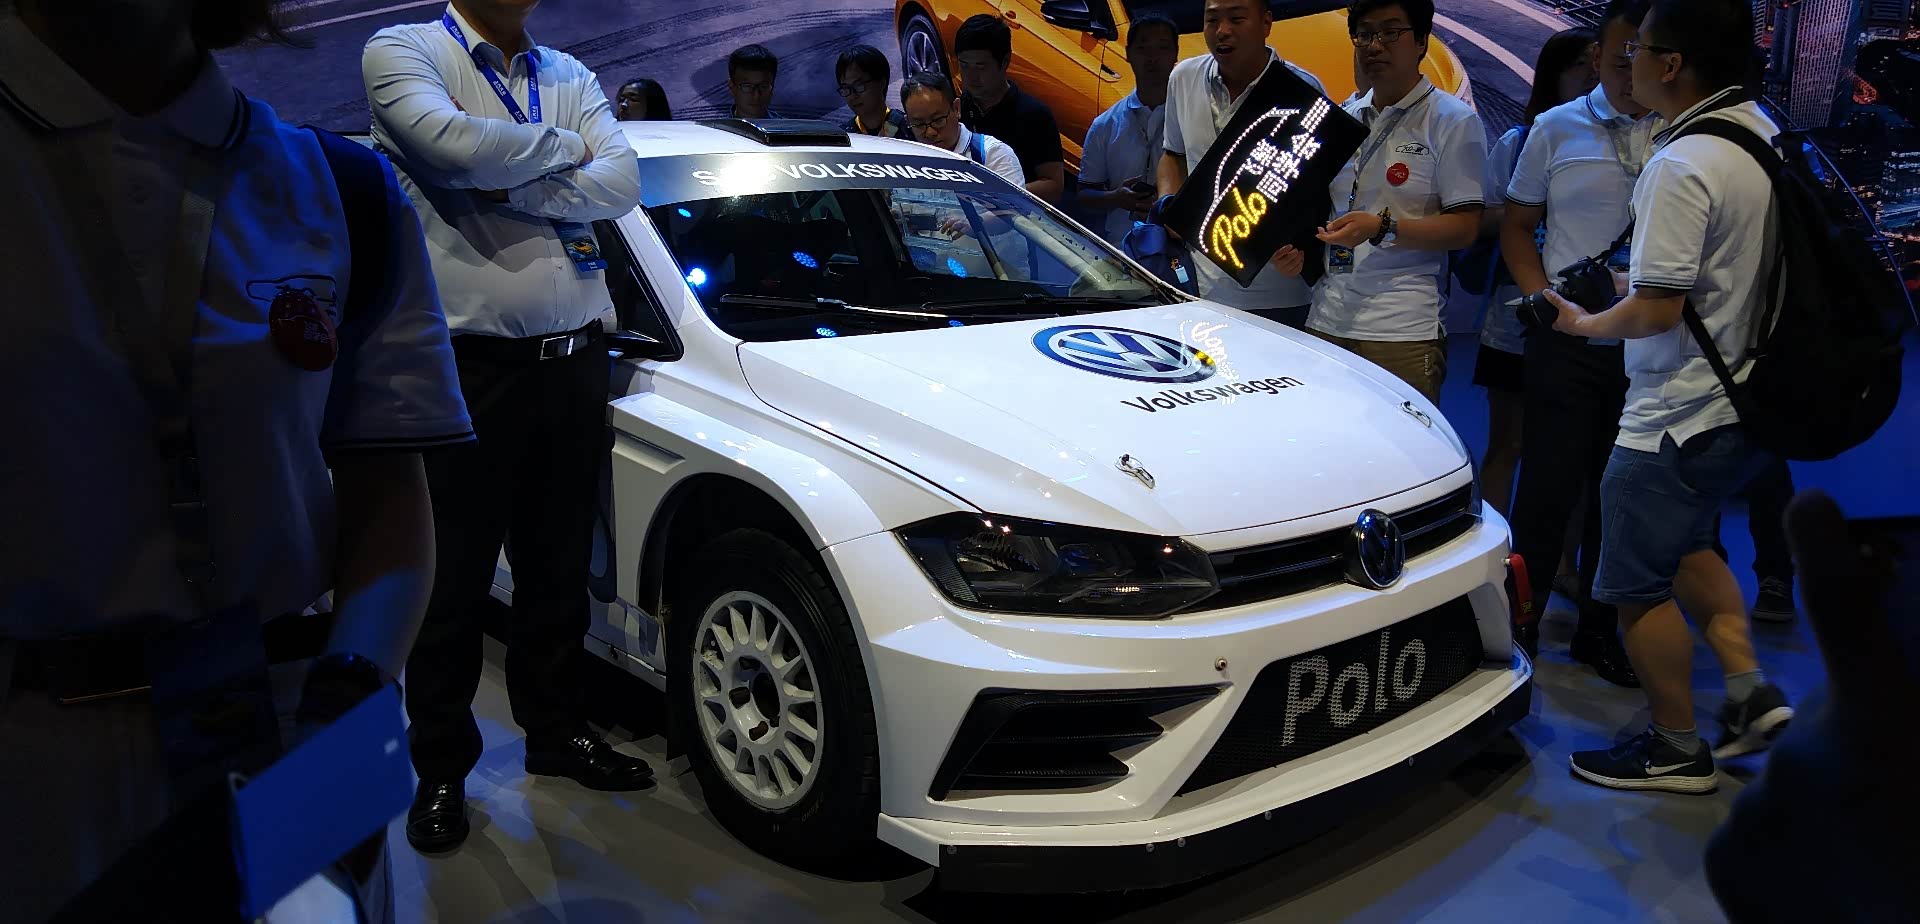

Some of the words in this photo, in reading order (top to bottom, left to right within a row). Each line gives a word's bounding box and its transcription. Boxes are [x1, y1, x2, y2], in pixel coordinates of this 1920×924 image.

[774, 162, 985, 185] VOLKSWAGEN
[1256, 132, 1322, 203] 同学会
[1212, 186, 1267, 269] Polo
[1120, 375, 1305, 413] Volkswagen
[1281, 627, 1427, 747] Polo
